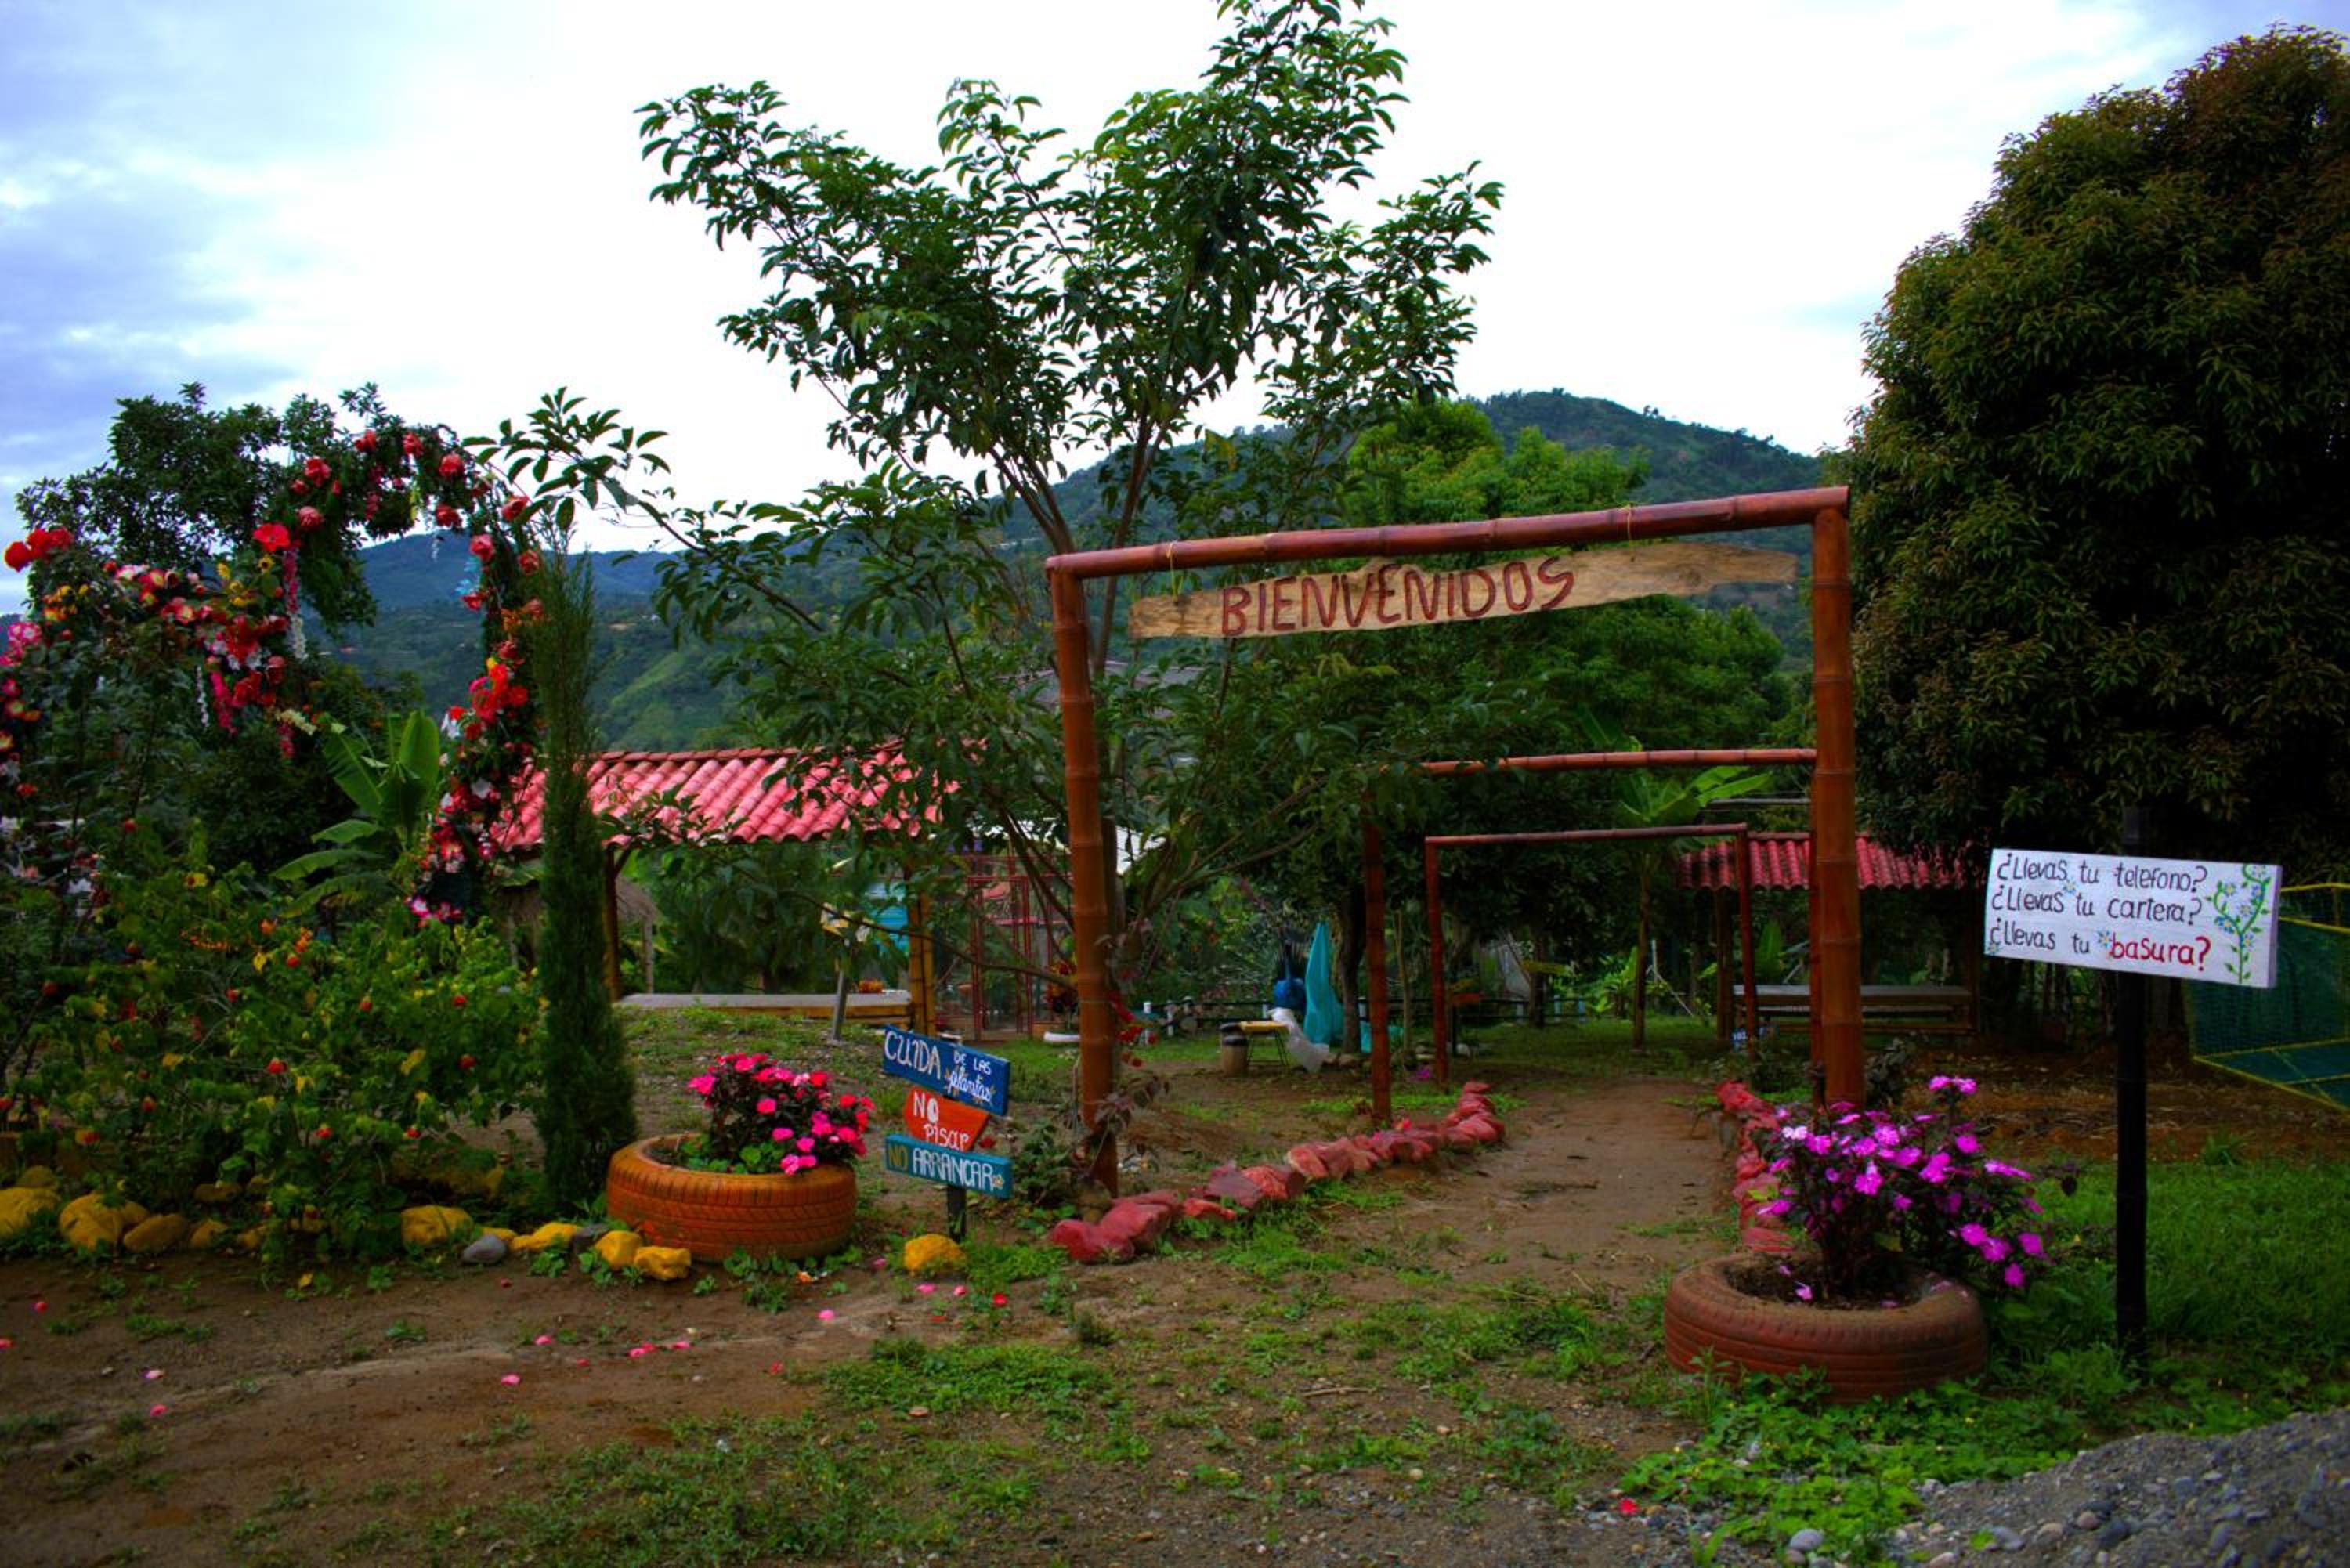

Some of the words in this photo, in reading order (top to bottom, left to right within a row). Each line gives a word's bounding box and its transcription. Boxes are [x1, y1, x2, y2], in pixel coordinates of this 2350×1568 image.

[1220, 556, 1574, 636] BIENVENIDOS
[2080, 861, 2100, 883] tu
[2076, 896, 2095, 916] tu
[2107, 897, 2203, 925] cartera?
[2073, 934, 2090, 954] tu
[884, 1031, 941, 1080] CUIDA
[954, 1051, 967, 1067] DE
[974, 1059, 991, 1075] LAS
[947, 1068, 991, 1103] plantas
[913, 1091, 939, 1123] NO
[889, 1143, 908, 1169] NO
[913, 1147, 994, 1191] ARRANCAR
